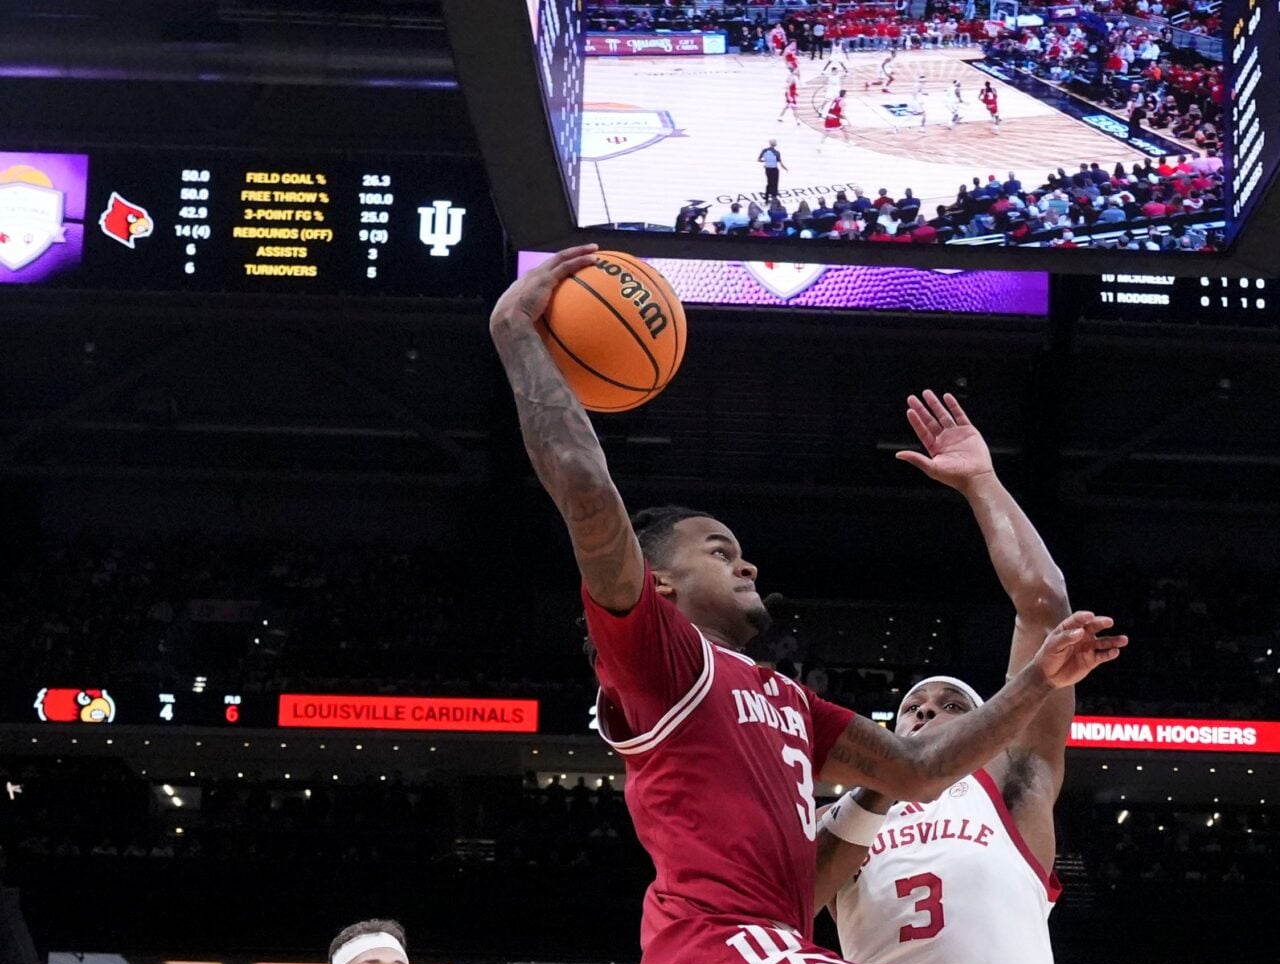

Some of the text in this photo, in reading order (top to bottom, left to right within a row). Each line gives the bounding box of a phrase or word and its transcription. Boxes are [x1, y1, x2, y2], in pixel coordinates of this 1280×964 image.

[246, 172, 280, 183] FIELD
[281, 173, 314, 184] GOAL
[241, 190, 271, 202] FREE
[272, 192, 317, 202] THROW
[244, 208, 294, 220] 3-POINT
[296, 210, 312, 221] FG
[175, 225, 190, 236] 14
[192, 225, 210, 239] (4)
[233, 226, 298, 239] REBOUNDS
[300, 228, 332, 242] (OFF)
[359, 230, 368, 241] 9
[186, 244, 377, 259] 6 ASSISTS 3
[185, 262, 376, 278] 6 TURNOVERS 5
[1256, 279, 1264, 288] 0
[1100, 292, 1265, 308] 11 RODGERS 0 1 1 0
[160, 704, 239, 722] 4 6
[293, 702, 524, 724] LOUISVILLE CARDINALS
[732, 689, 809, 743] INDIA
[1071, 722, 1256, 745] INDIANA HOOSIERS
[782, 744, 816, 842] 3
[895, 872, 944, 943] 3
